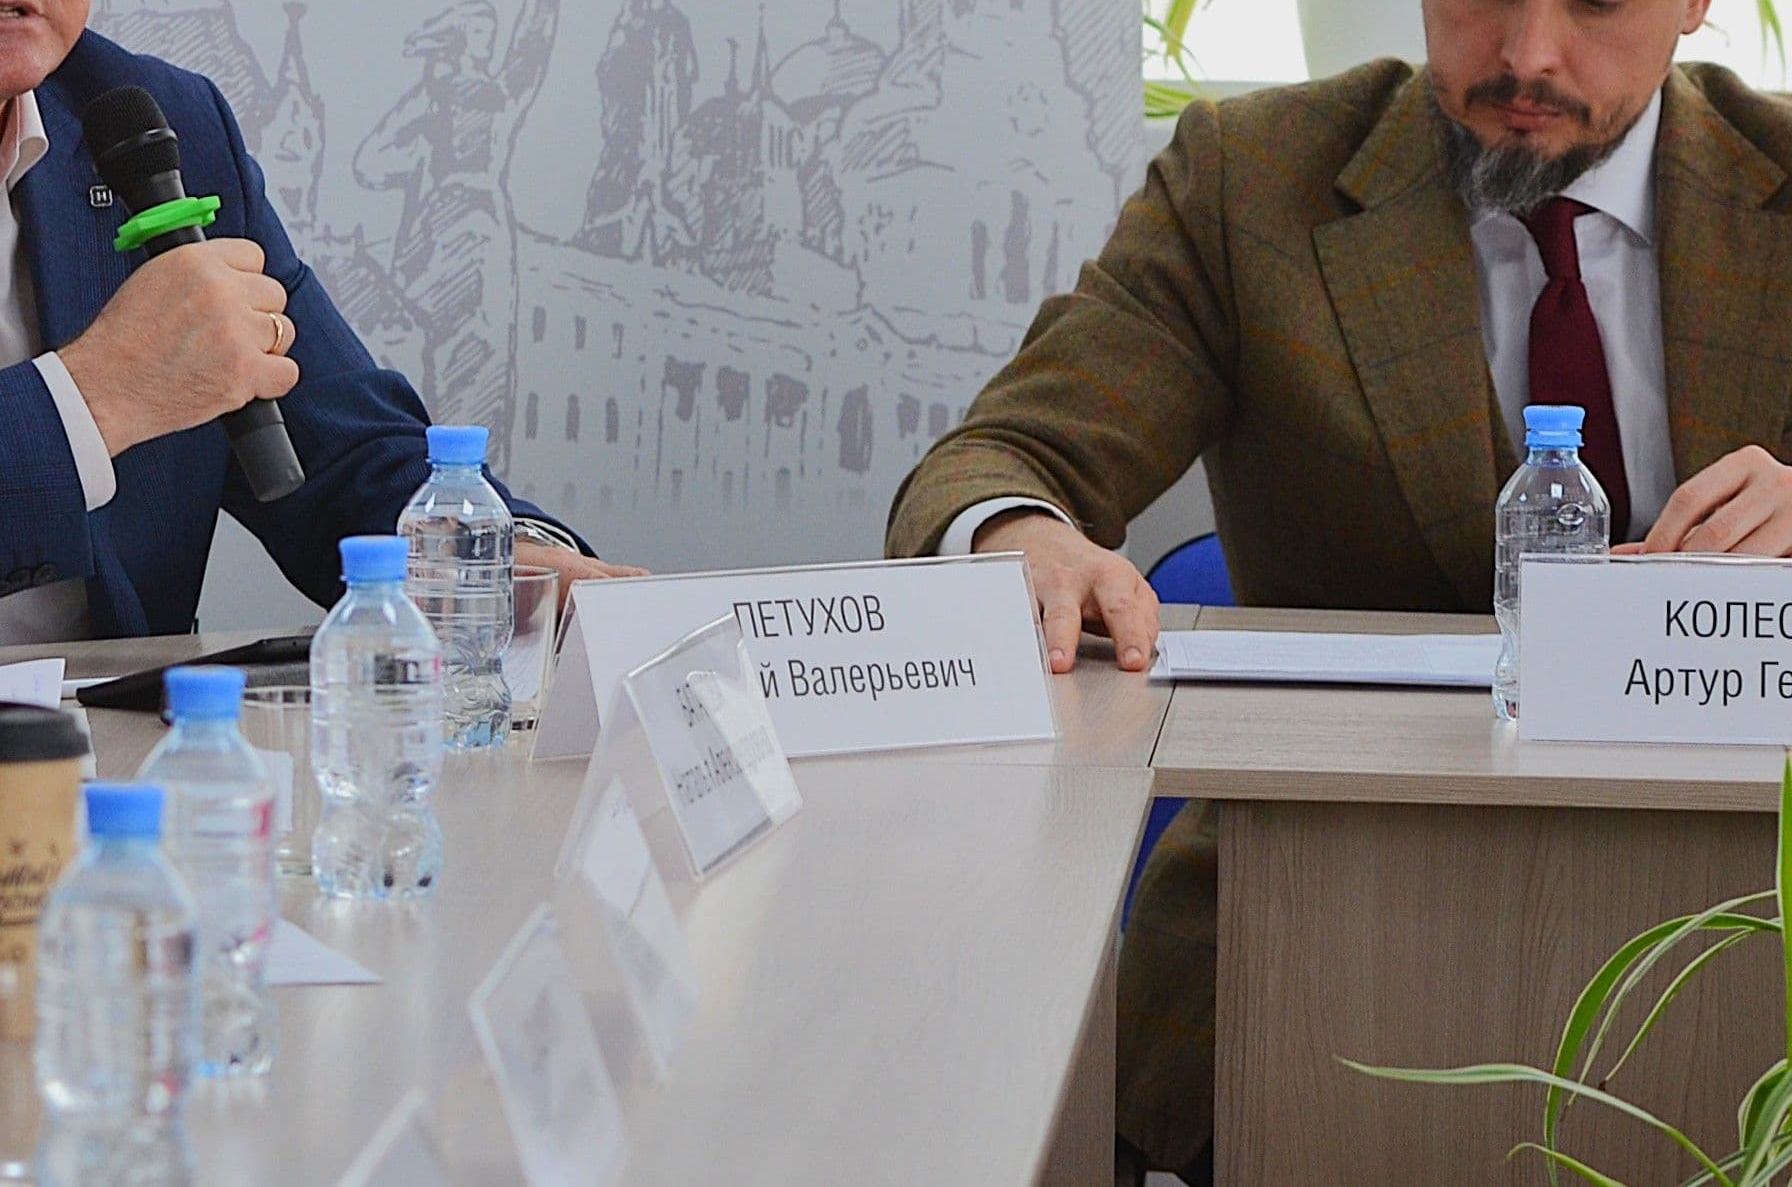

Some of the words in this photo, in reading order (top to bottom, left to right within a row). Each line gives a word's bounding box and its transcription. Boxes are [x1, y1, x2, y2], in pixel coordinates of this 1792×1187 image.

[732, 595, 886, 639] ПЕТУХОВ
[787, 658, 977, 702] Валерьевич
[1624, 658, 1744, 707] Артур
